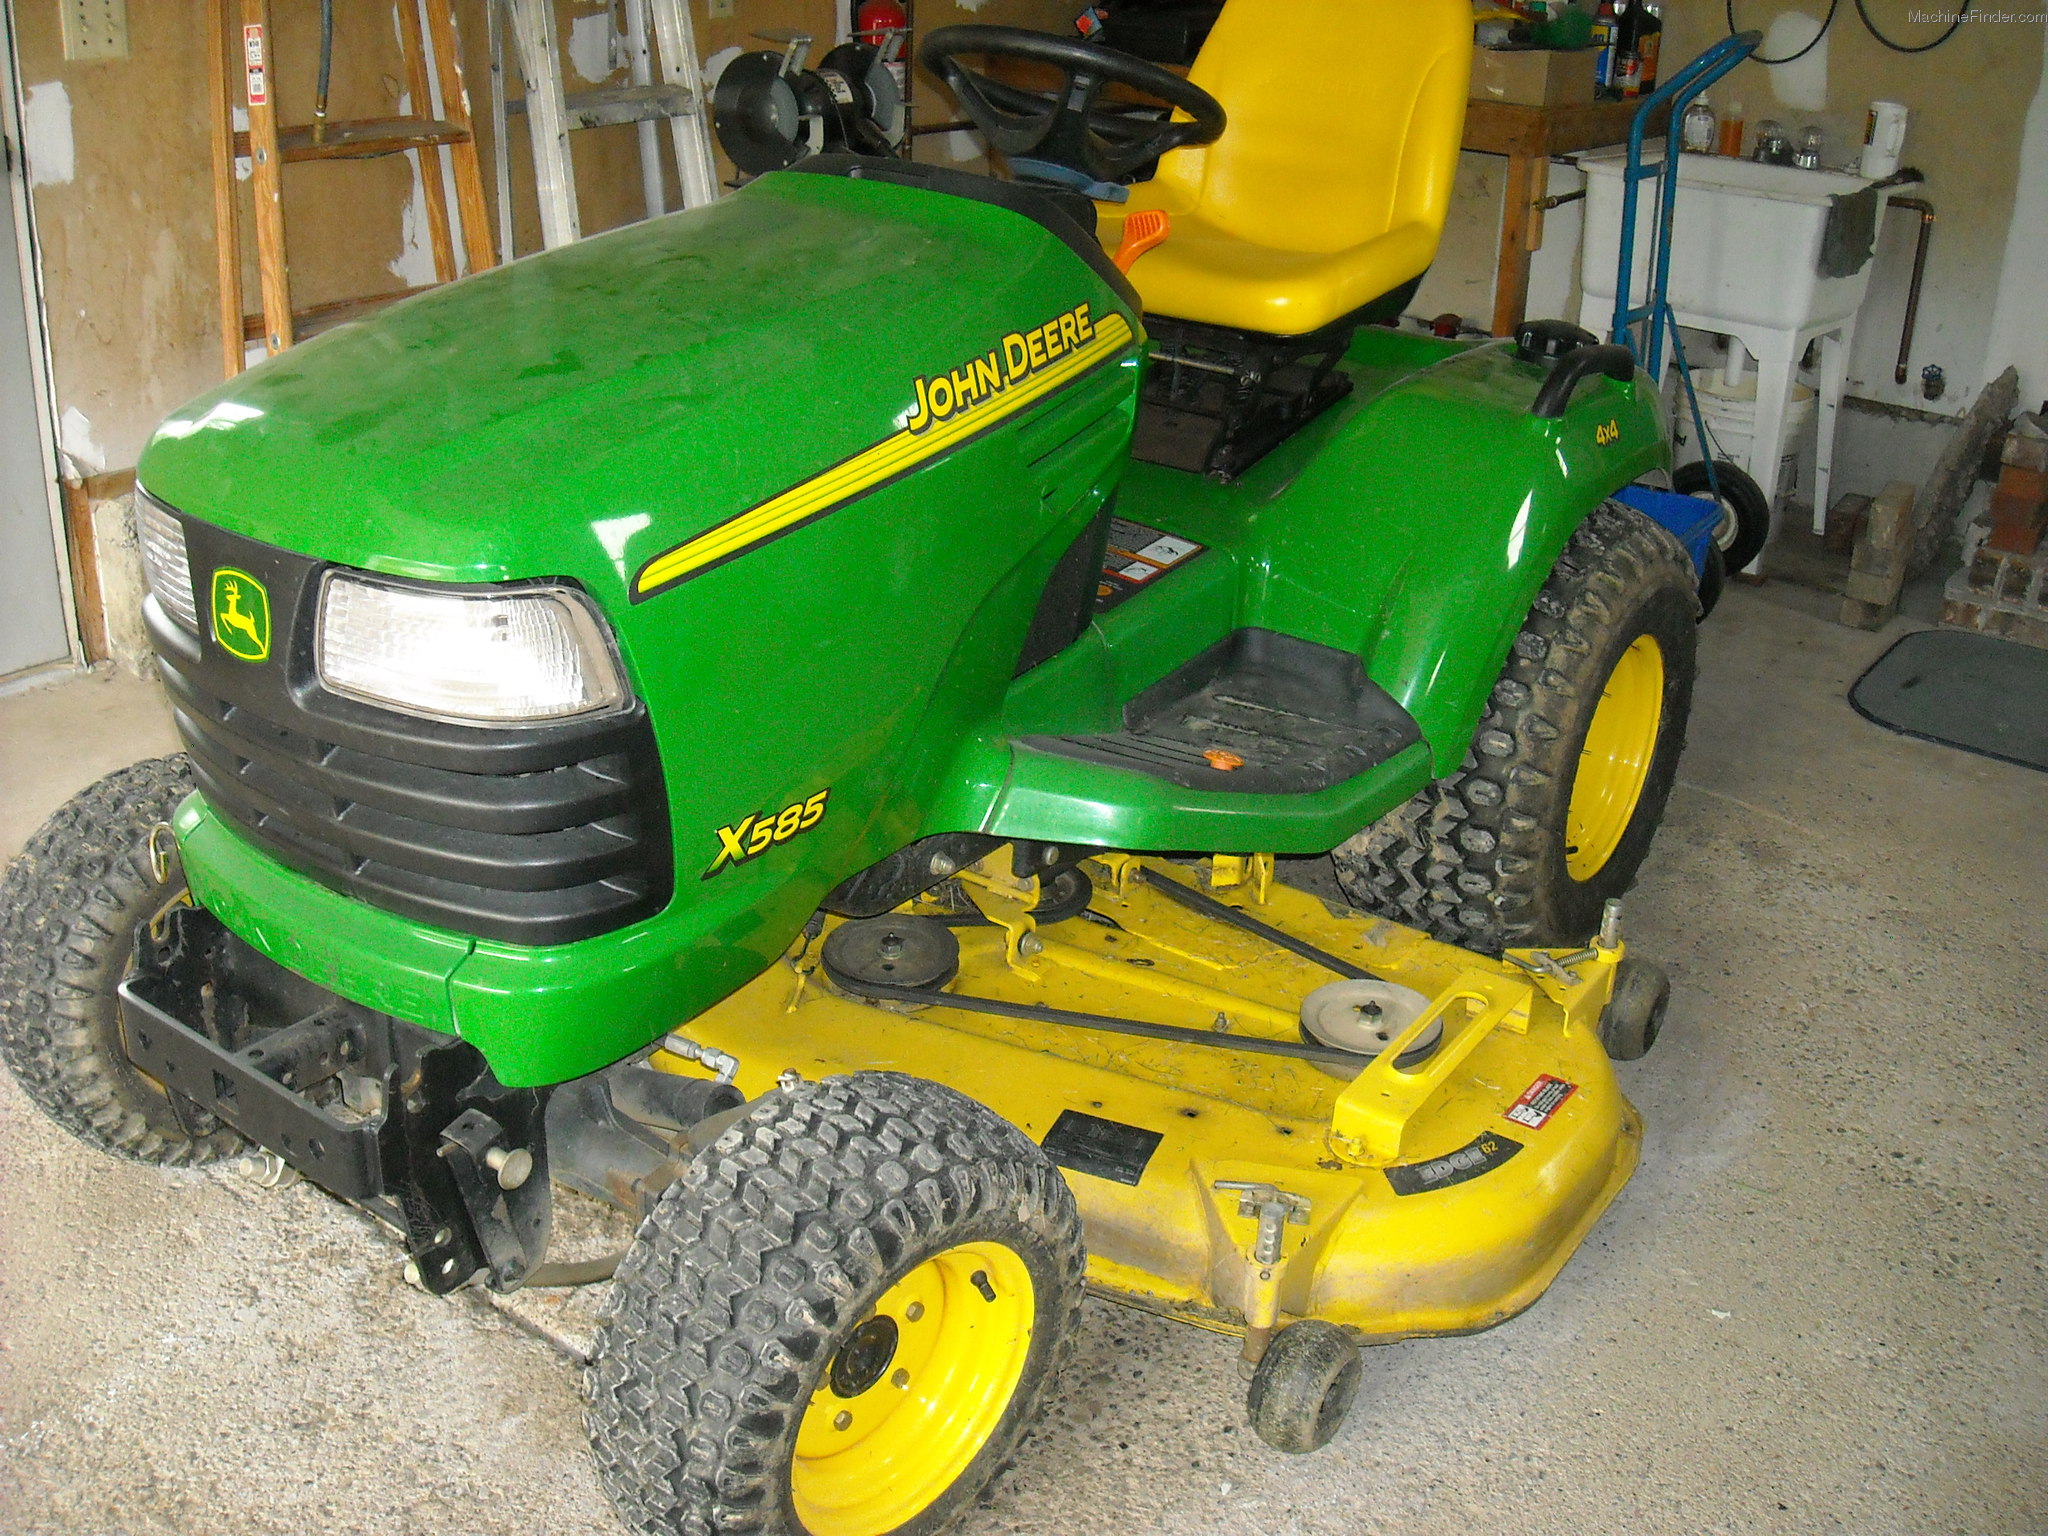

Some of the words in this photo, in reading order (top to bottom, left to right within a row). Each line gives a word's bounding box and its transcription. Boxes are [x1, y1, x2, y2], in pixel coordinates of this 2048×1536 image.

[908, 350, 1003, 433] JOHN
[1002, 302, 1095, 382] DEERE
[1596, 419, 1619, 446] 4x4
[703, 788, 829, 879] X585
[1415, 1147, 1487, 1185] EDGE
[1480, 1140, 1499, 1154] 62
